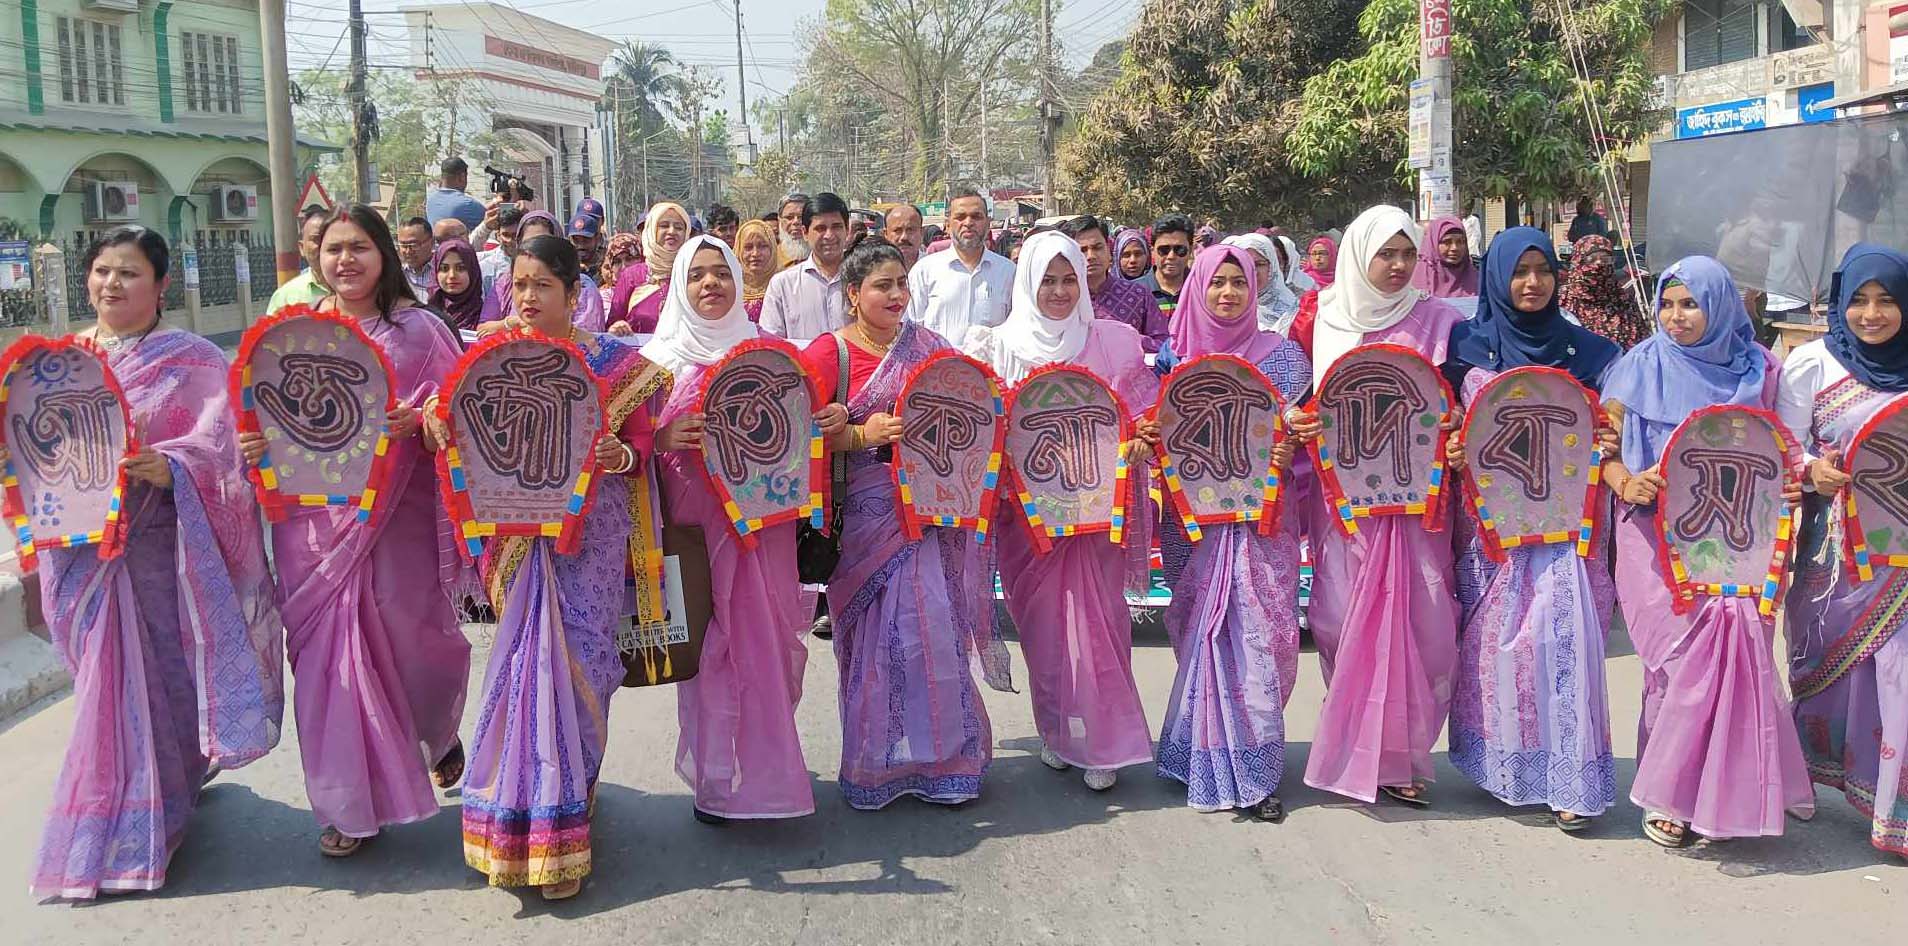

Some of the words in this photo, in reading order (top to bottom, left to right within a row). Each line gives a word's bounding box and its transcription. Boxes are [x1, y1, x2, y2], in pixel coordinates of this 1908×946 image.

[12, 386, 120, 491] আ
[703, 364, 801, 485] তি
[902, 391, 993, 476] ক
[1022, 405, 1117, 491] না
[1167, 371, 1274, 482] রী
[1321, 360, 1429, 486] দি
[1478, 404, 1578, 502] ব
[1674, 447, 1778, 552] স
